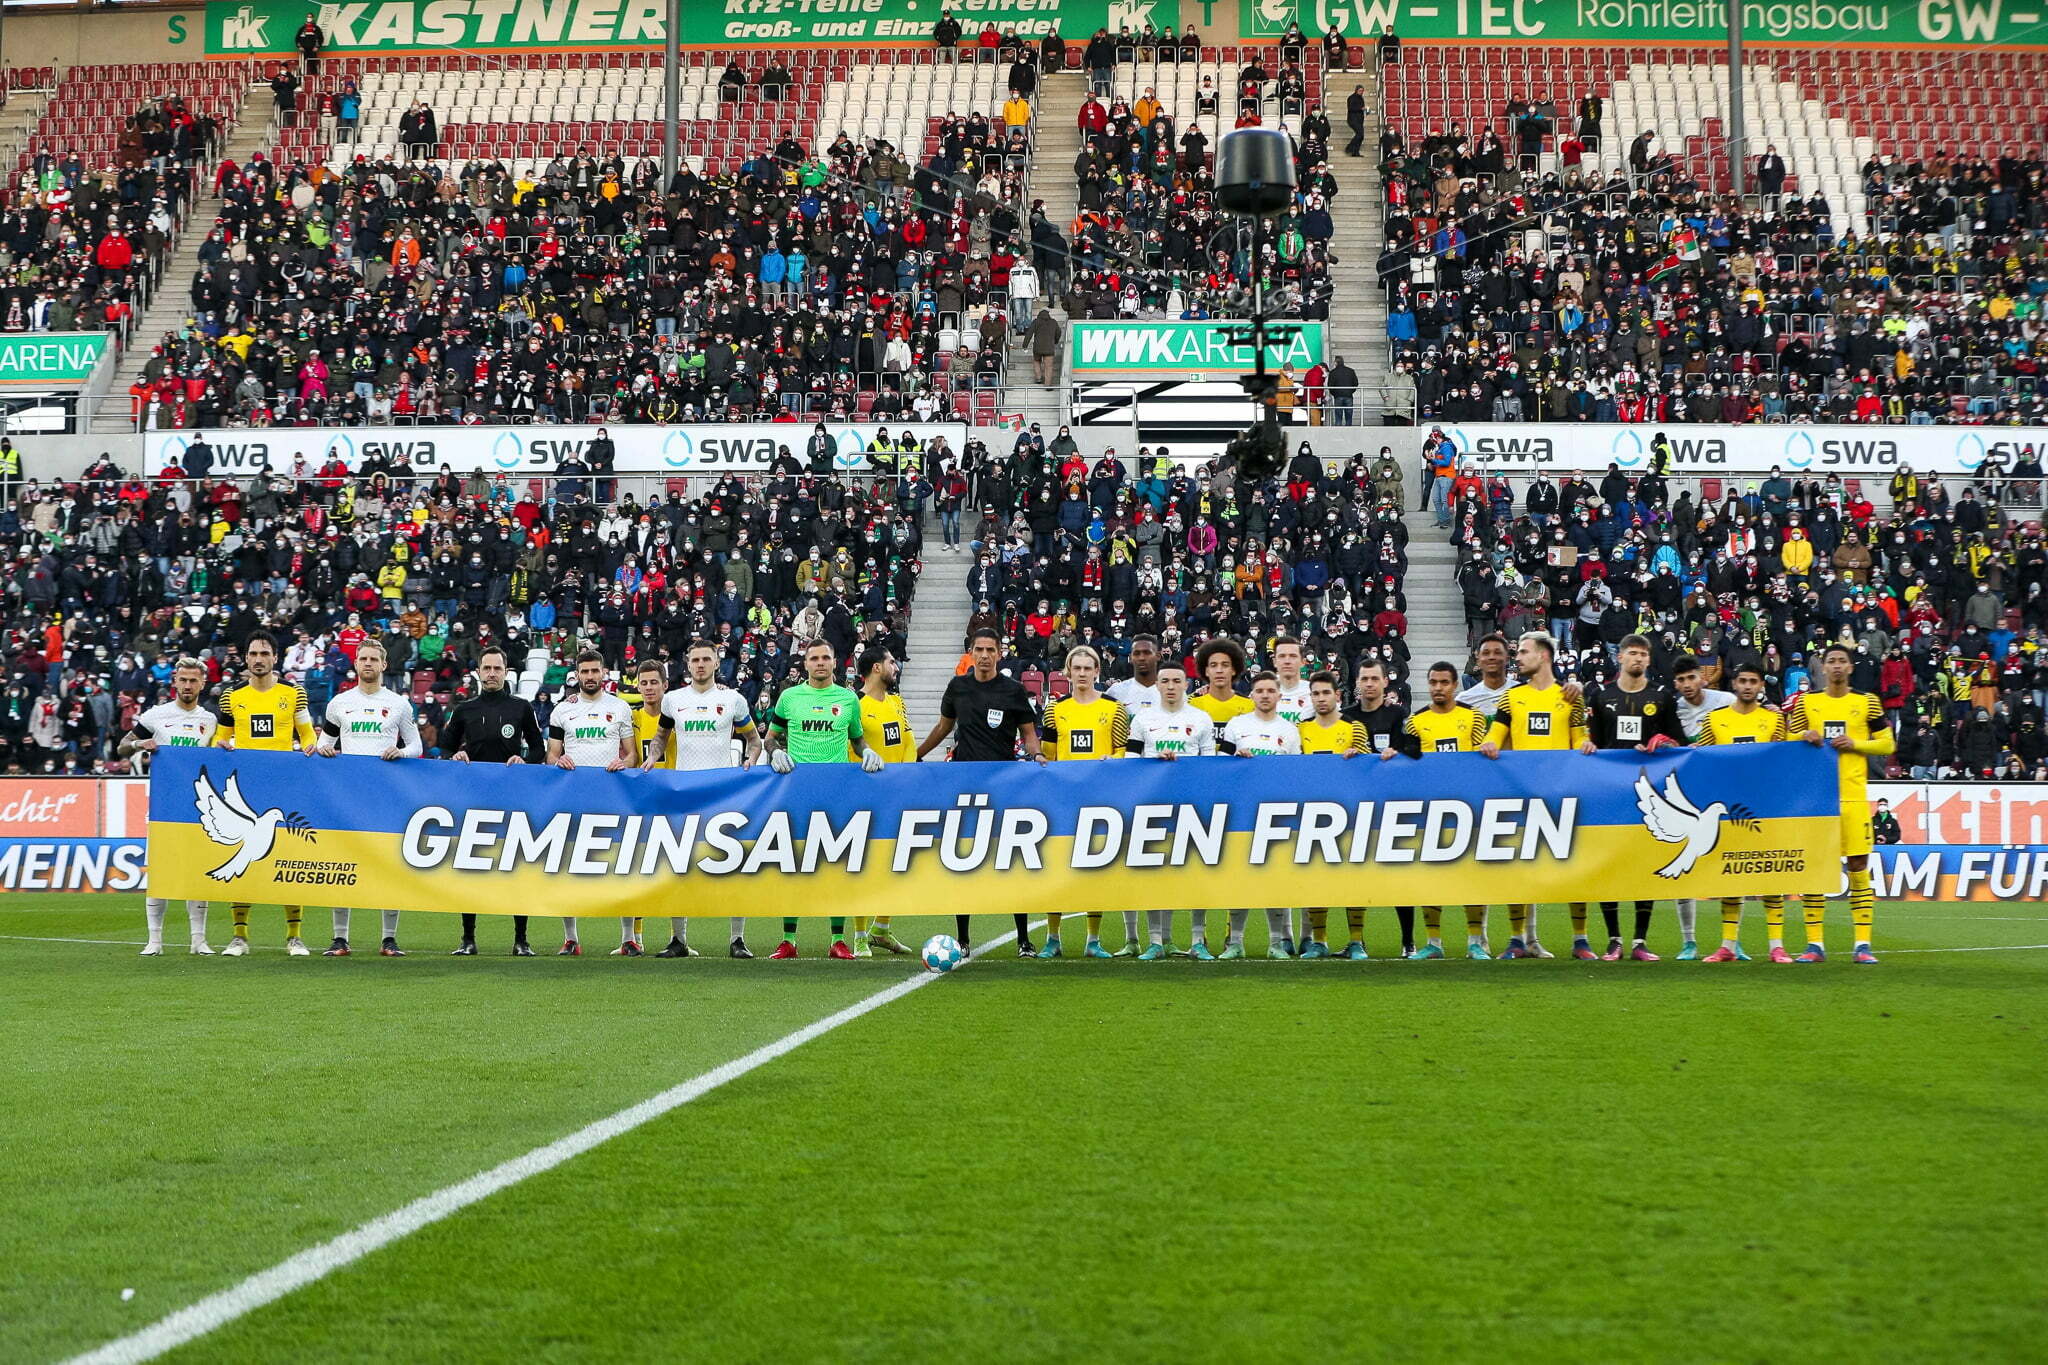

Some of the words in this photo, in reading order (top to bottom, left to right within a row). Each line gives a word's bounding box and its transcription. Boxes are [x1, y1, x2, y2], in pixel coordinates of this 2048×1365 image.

[168, 15, 187, 44] S
[317, 0, 667, 46] KASTNER
[724, 21, 801, 38] Groß-
[811, 19, 867, 37] und
[208, 443, 268, 467] wa
[699, 438, 776, 463] swa
[1476, 437, 1553, 463] swa
[1822, 440, 1898, 465] swa
[252, 719, 272, 732] 1&1
[351, 721, 382, 733] WWK
[684, 720, 717, 732] WWK
[802, 719, 835, 732] WWK
[1529, 717, 1549, 730] 1&1
[1619, 721, 1639, 733] 1&1
[575, 727, 607, 739] WWK
[885, 727, 899, 740] 1&1
[1072, 734, 1092, 747] 1&1
[1155, 740, 1187, 752] WWK
[401, 805, 871, 875] GEMEINSAM
[892, 793, 1048, 872] FÜR
[1070, 803, 1228, 868] DEN
[1249, 797, 1578, 864] FRIEDEN
[1721, 850, 1804, 860] FRIEDENSSTADT
[275, 860, 357, 872] FRIEDENSSTADT
[1721, 860, 1805, 875] AUGSBURG
[273, 871, 357, 886] AUGSBURG
